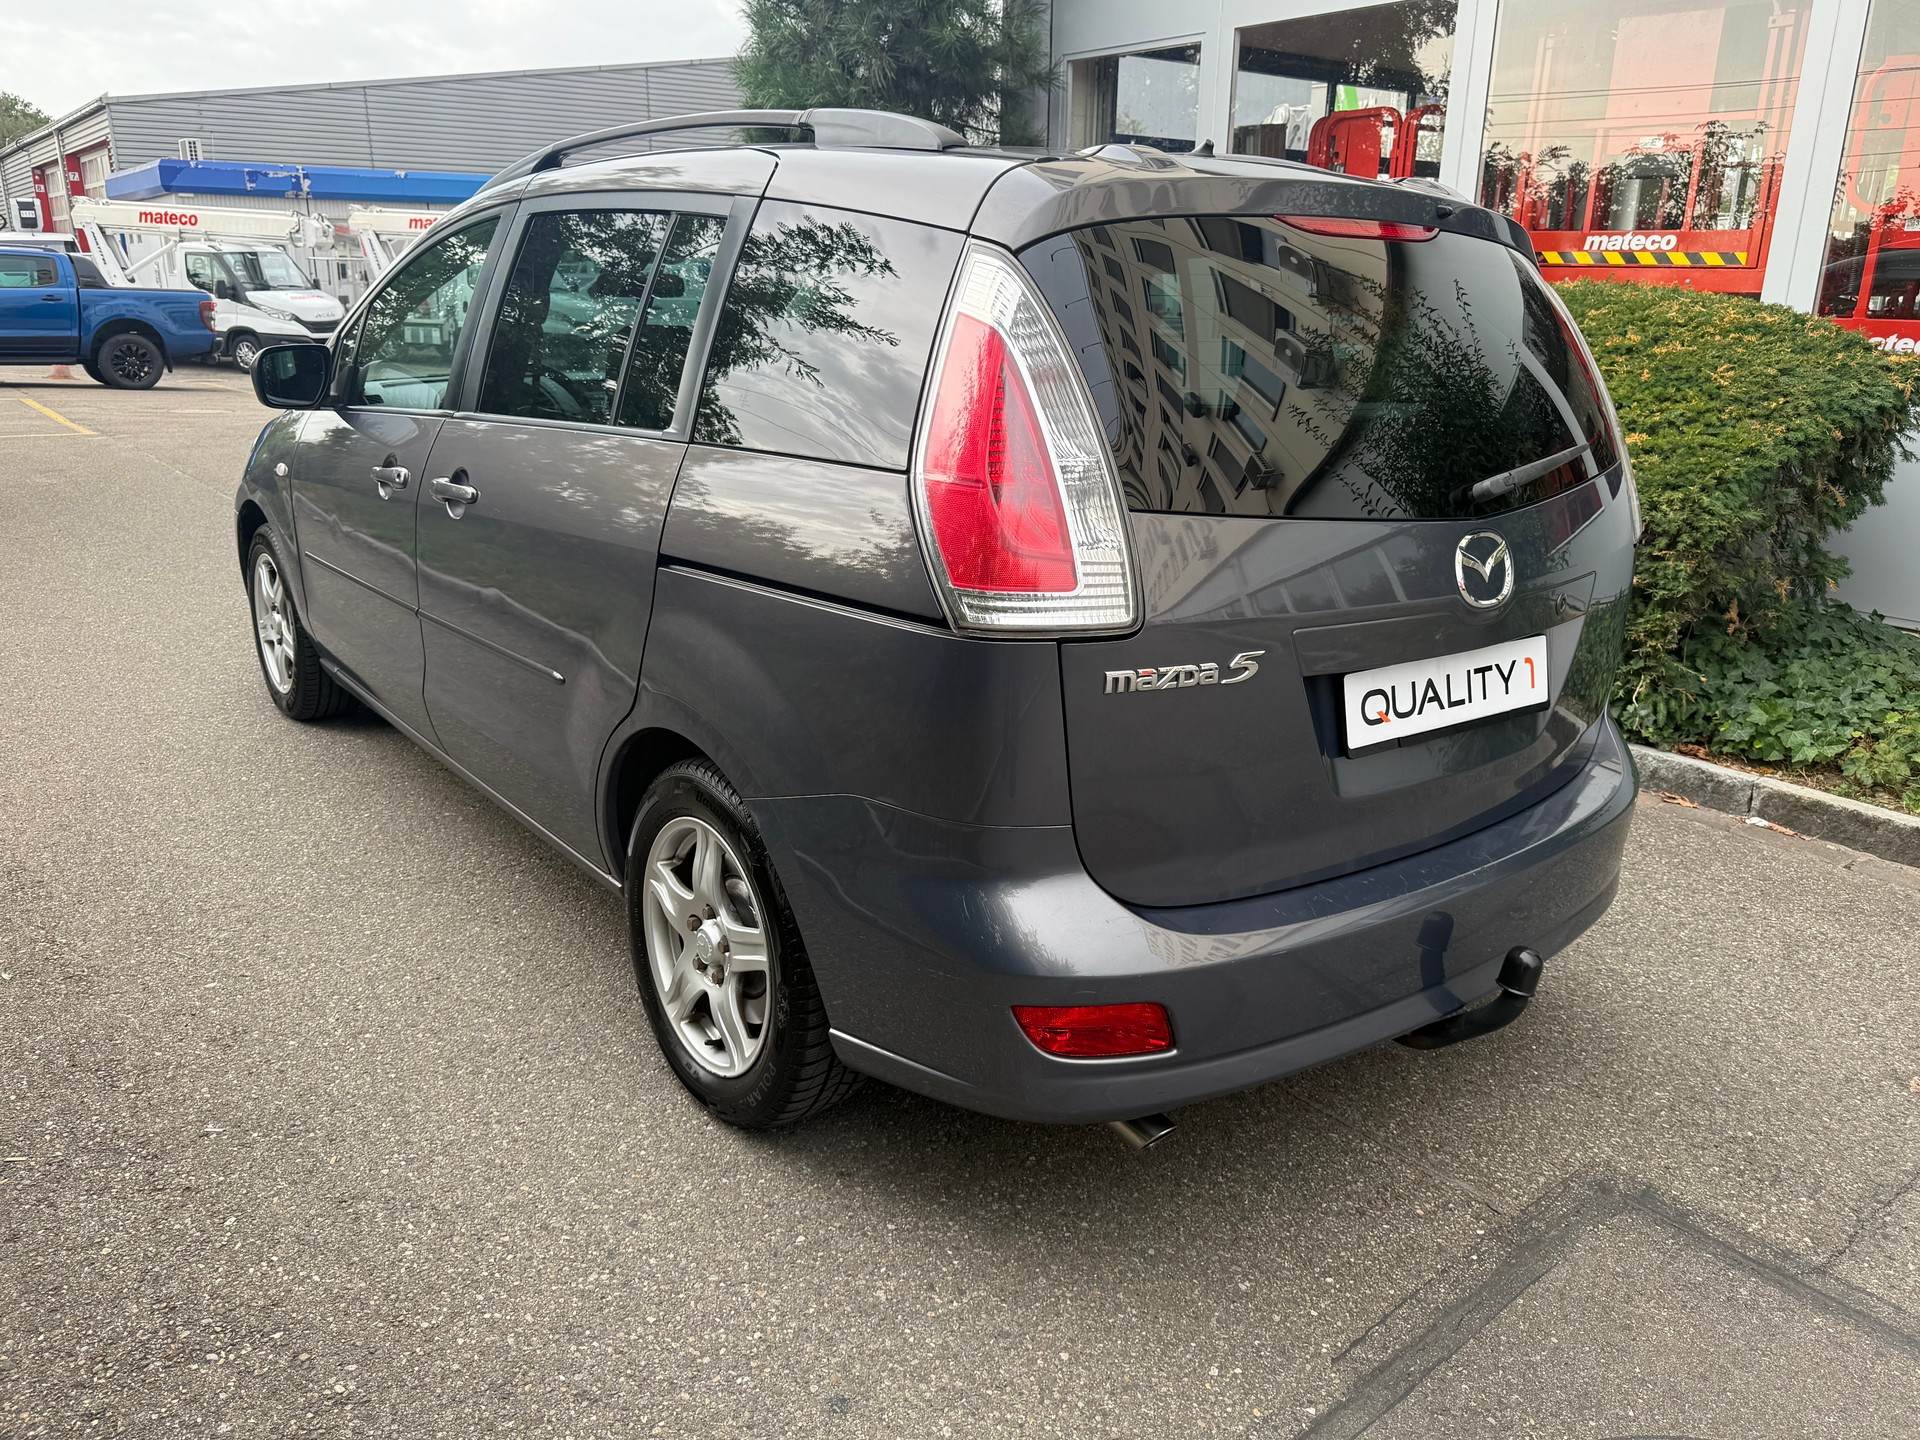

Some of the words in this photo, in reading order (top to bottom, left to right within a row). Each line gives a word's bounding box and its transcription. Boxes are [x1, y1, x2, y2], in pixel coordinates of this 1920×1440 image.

[138, 211, 198, 226] mateco
[1583, 231, 1677, 251] mateco
[1221, 650, 1265, 684] 5
[1361, 659, 1517, 726] QUALITY
[1524, 657, 1535, 689] 1
